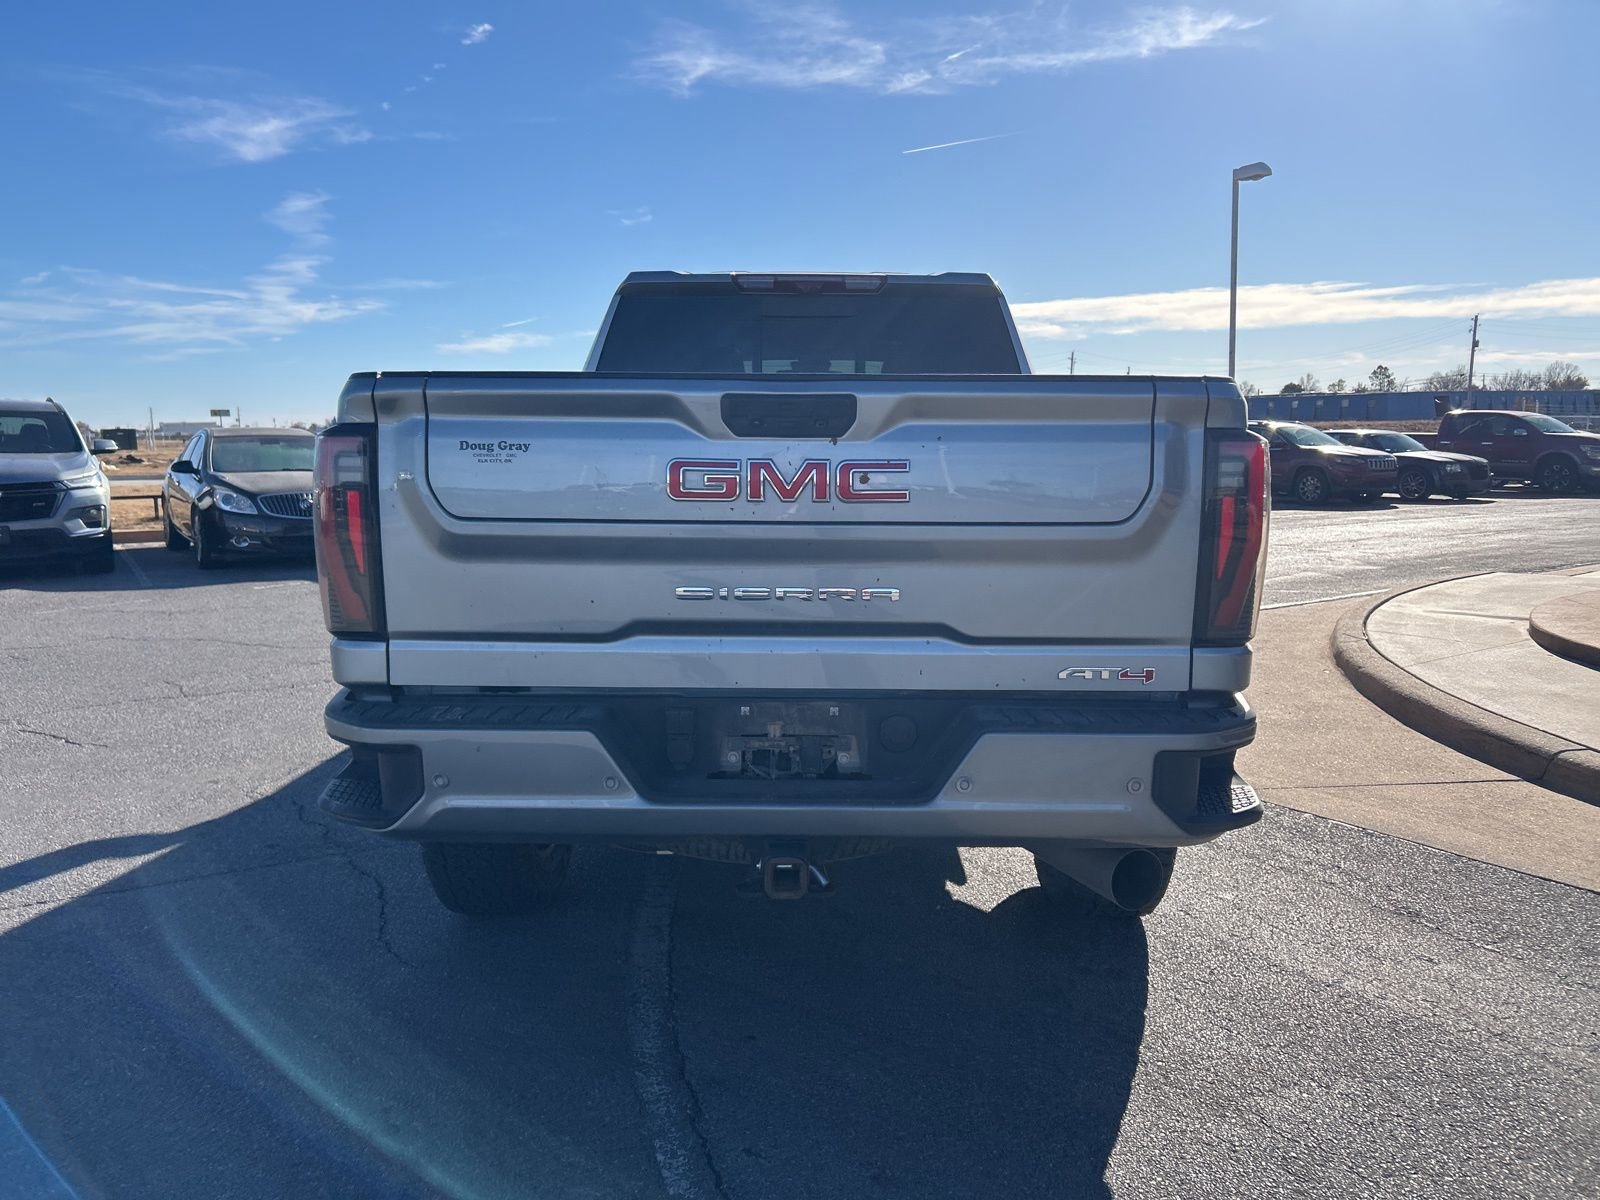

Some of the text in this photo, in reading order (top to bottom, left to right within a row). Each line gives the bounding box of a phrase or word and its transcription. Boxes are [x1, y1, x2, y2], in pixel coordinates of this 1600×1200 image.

[459, 440, 531, 453] Doug Gray
[666, 457, 910, 503] GMC
[675, 586, 900, 602] SIERRA
[1058, 667, 1156, 685] AT4
